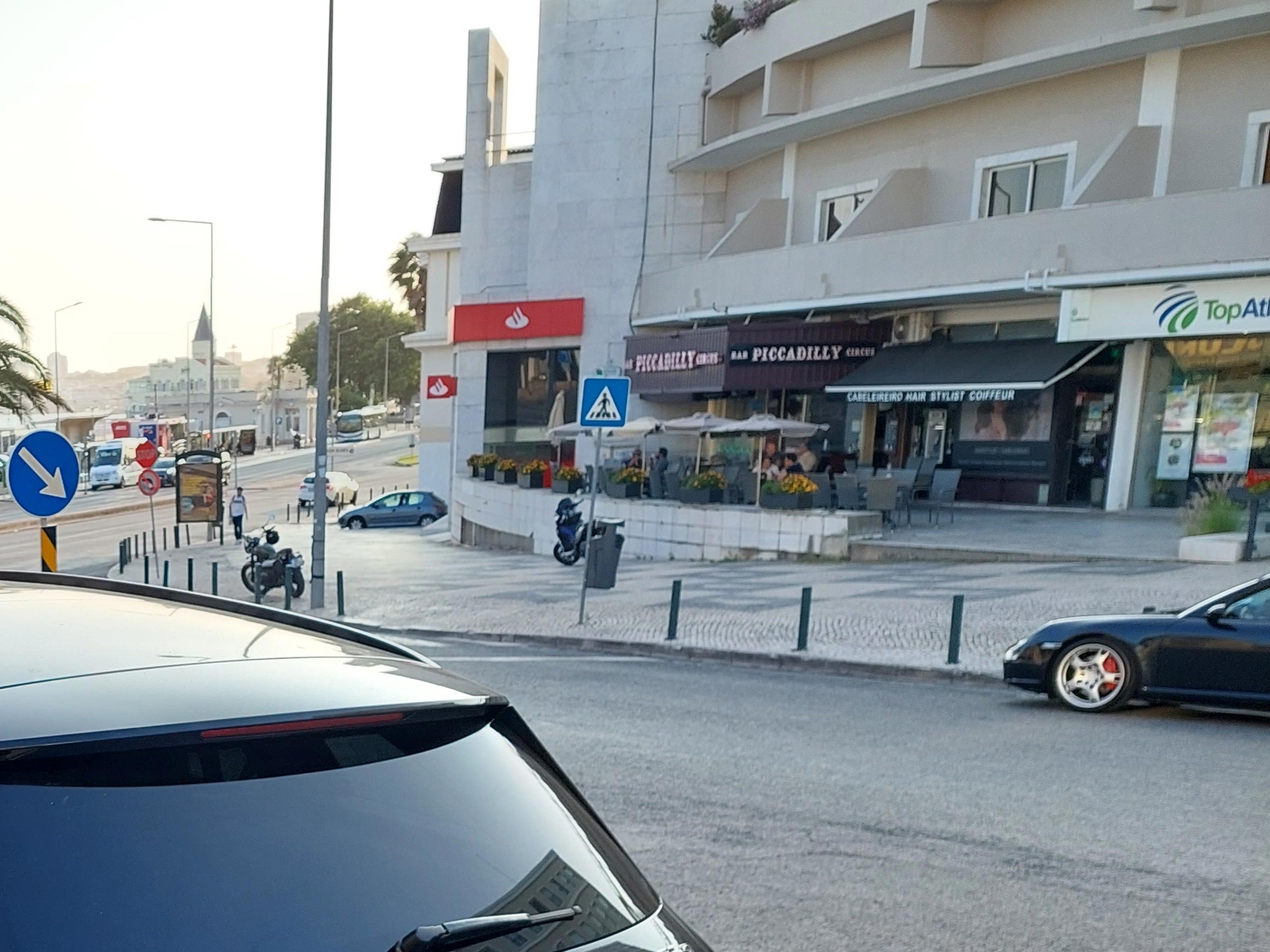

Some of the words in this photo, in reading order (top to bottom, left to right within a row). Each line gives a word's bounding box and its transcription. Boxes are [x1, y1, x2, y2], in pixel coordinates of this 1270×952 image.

[635, 350, 696, 373] PICCADILLY
[731, 350, 748, 360] BAR
[752, 345, 843, 362] PICCADILLY
[846, 347, 876, 357] CIRCUS
[847, 391, 903, 402] CABELEIREIRO
[905, 391, 927, 402] HAIR
[931, 390, 965, 402] STYLIST
[969, 389, 1016, 401] COIFFEUR
